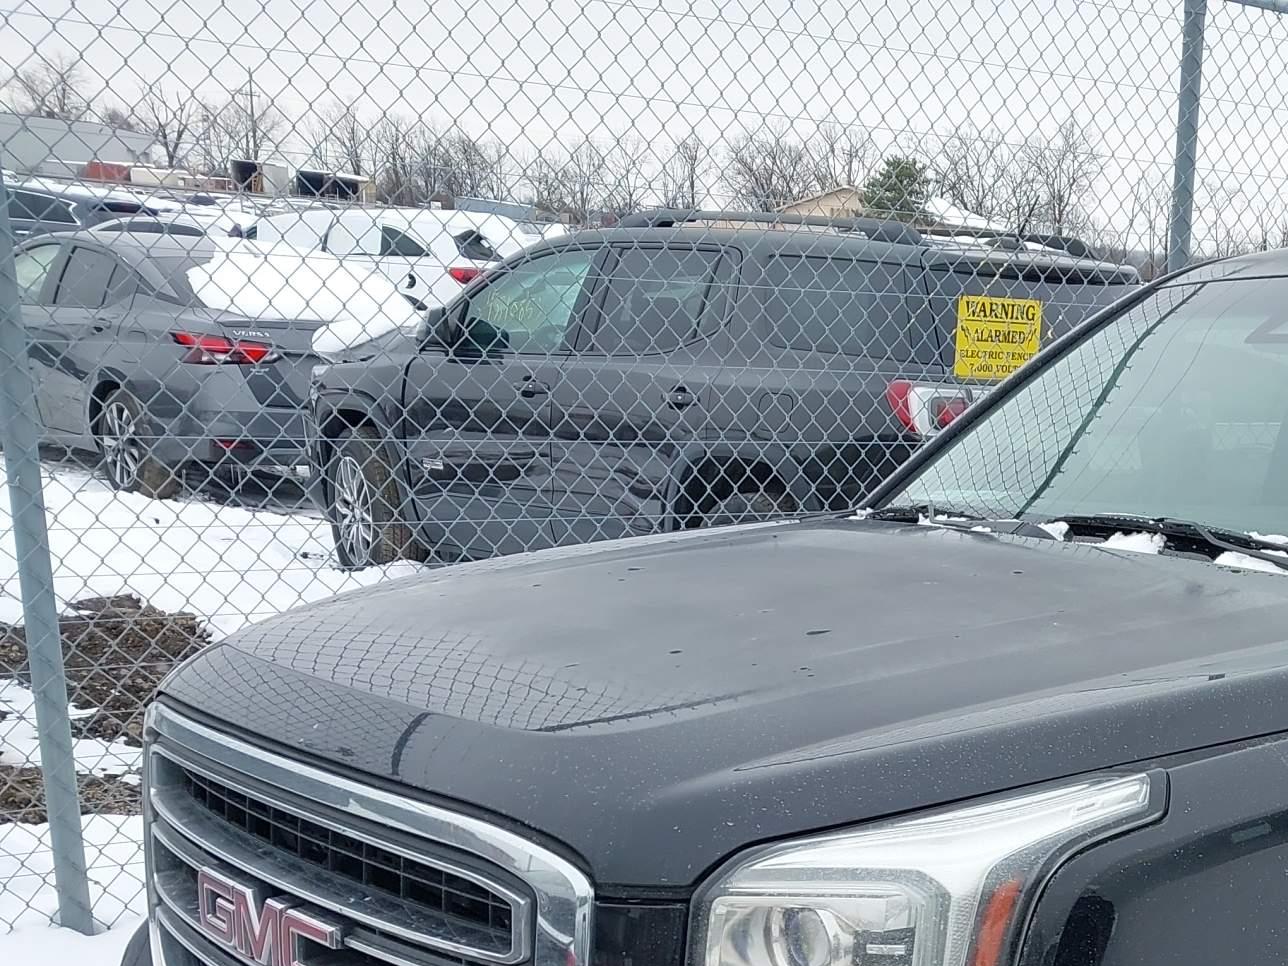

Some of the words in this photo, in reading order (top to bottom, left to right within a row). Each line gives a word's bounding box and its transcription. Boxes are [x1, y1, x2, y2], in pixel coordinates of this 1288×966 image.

[966, 301, 1036, 321] WARNING
[974, 328, 1026, 345] ALARMED
[960, 349, 1004, 360] ELECTRIC
